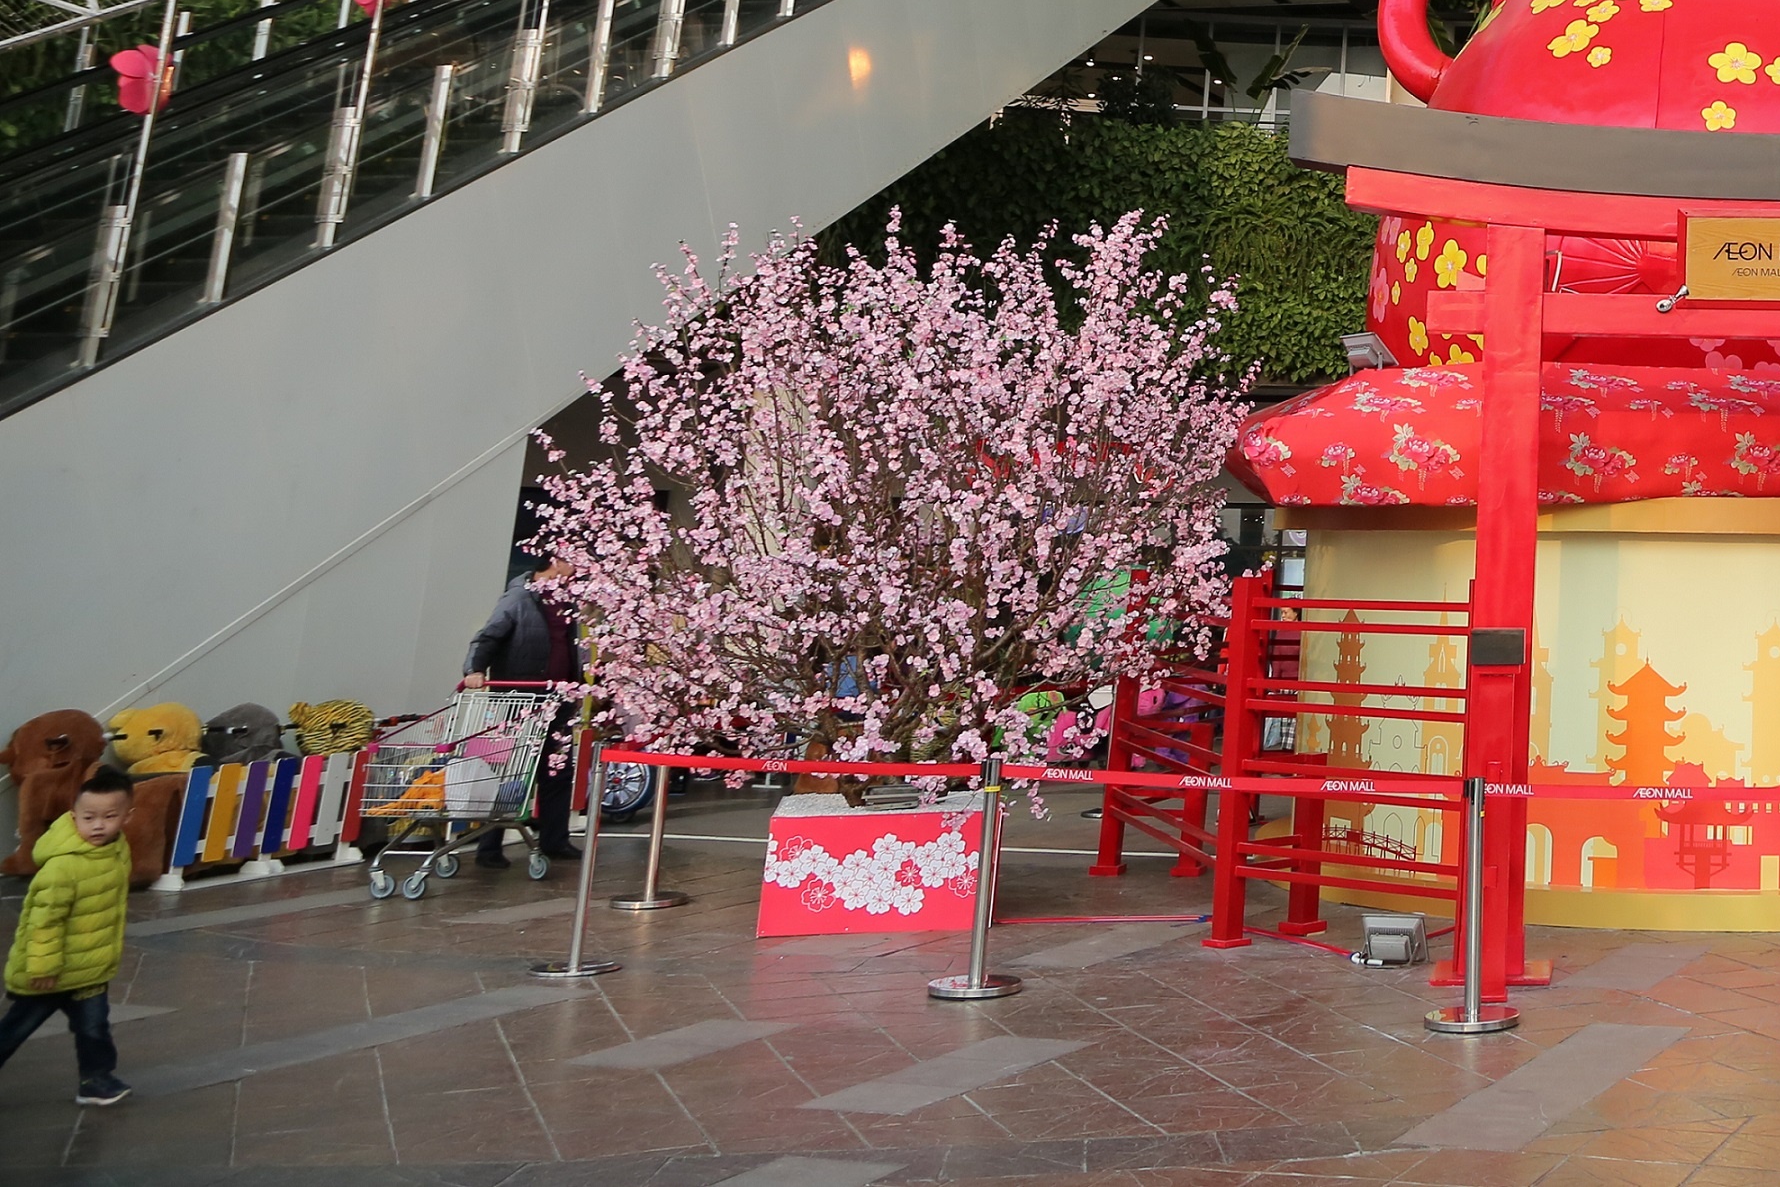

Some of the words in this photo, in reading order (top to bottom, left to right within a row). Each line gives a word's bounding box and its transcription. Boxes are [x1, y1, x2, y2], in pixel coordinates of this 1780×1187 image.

[1068, 769, 1094, 781] MALL
[1206, 777, 1232, 788] MALL
[1349, 781, 1376, 792] MALL
[1505, 784, 1534, 795] MALL
[1664, 788, 1693, 799] MALL
